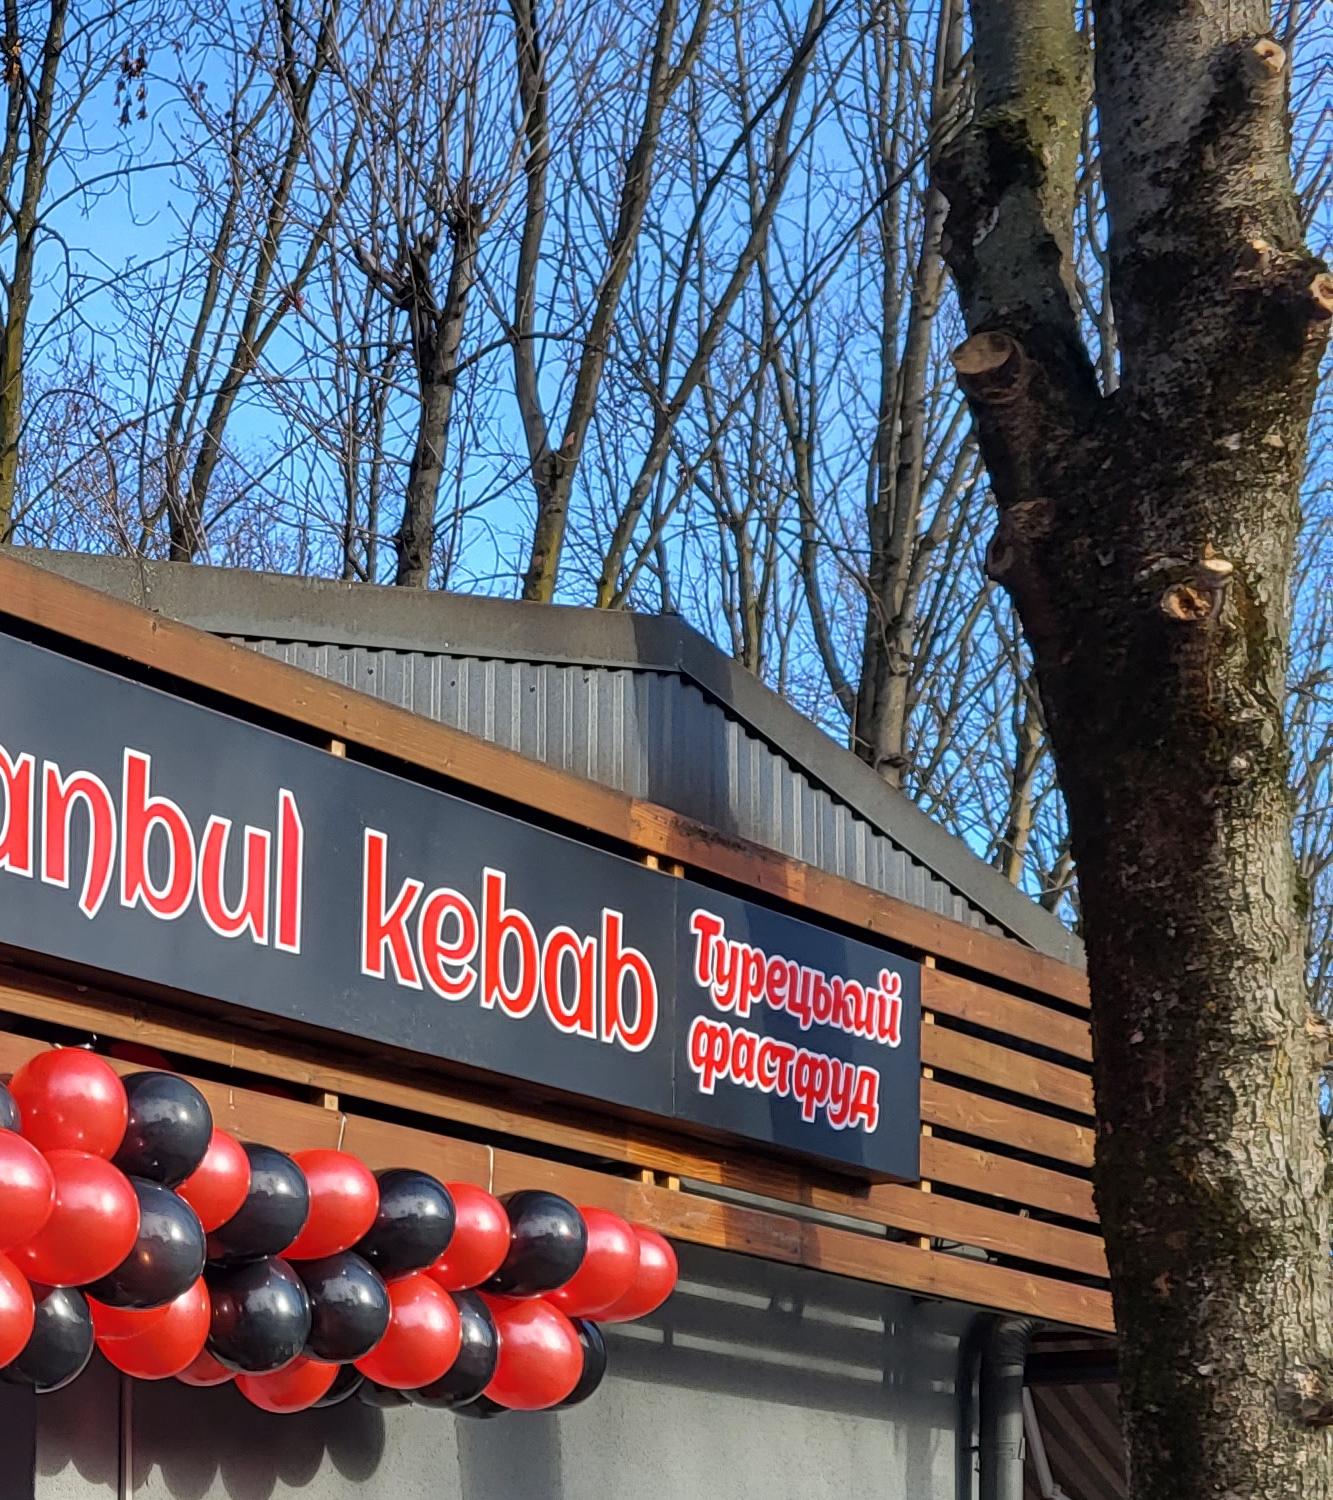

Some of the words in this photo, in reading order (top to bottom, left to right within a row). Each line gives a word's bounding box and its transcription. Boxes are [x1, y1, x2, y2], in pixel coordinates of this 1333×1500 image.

[361, 827, 658, 1053] kebab
[689, 908, 903, 1048] Турецький
[687, 1015, 881, 1133] фастфуд
